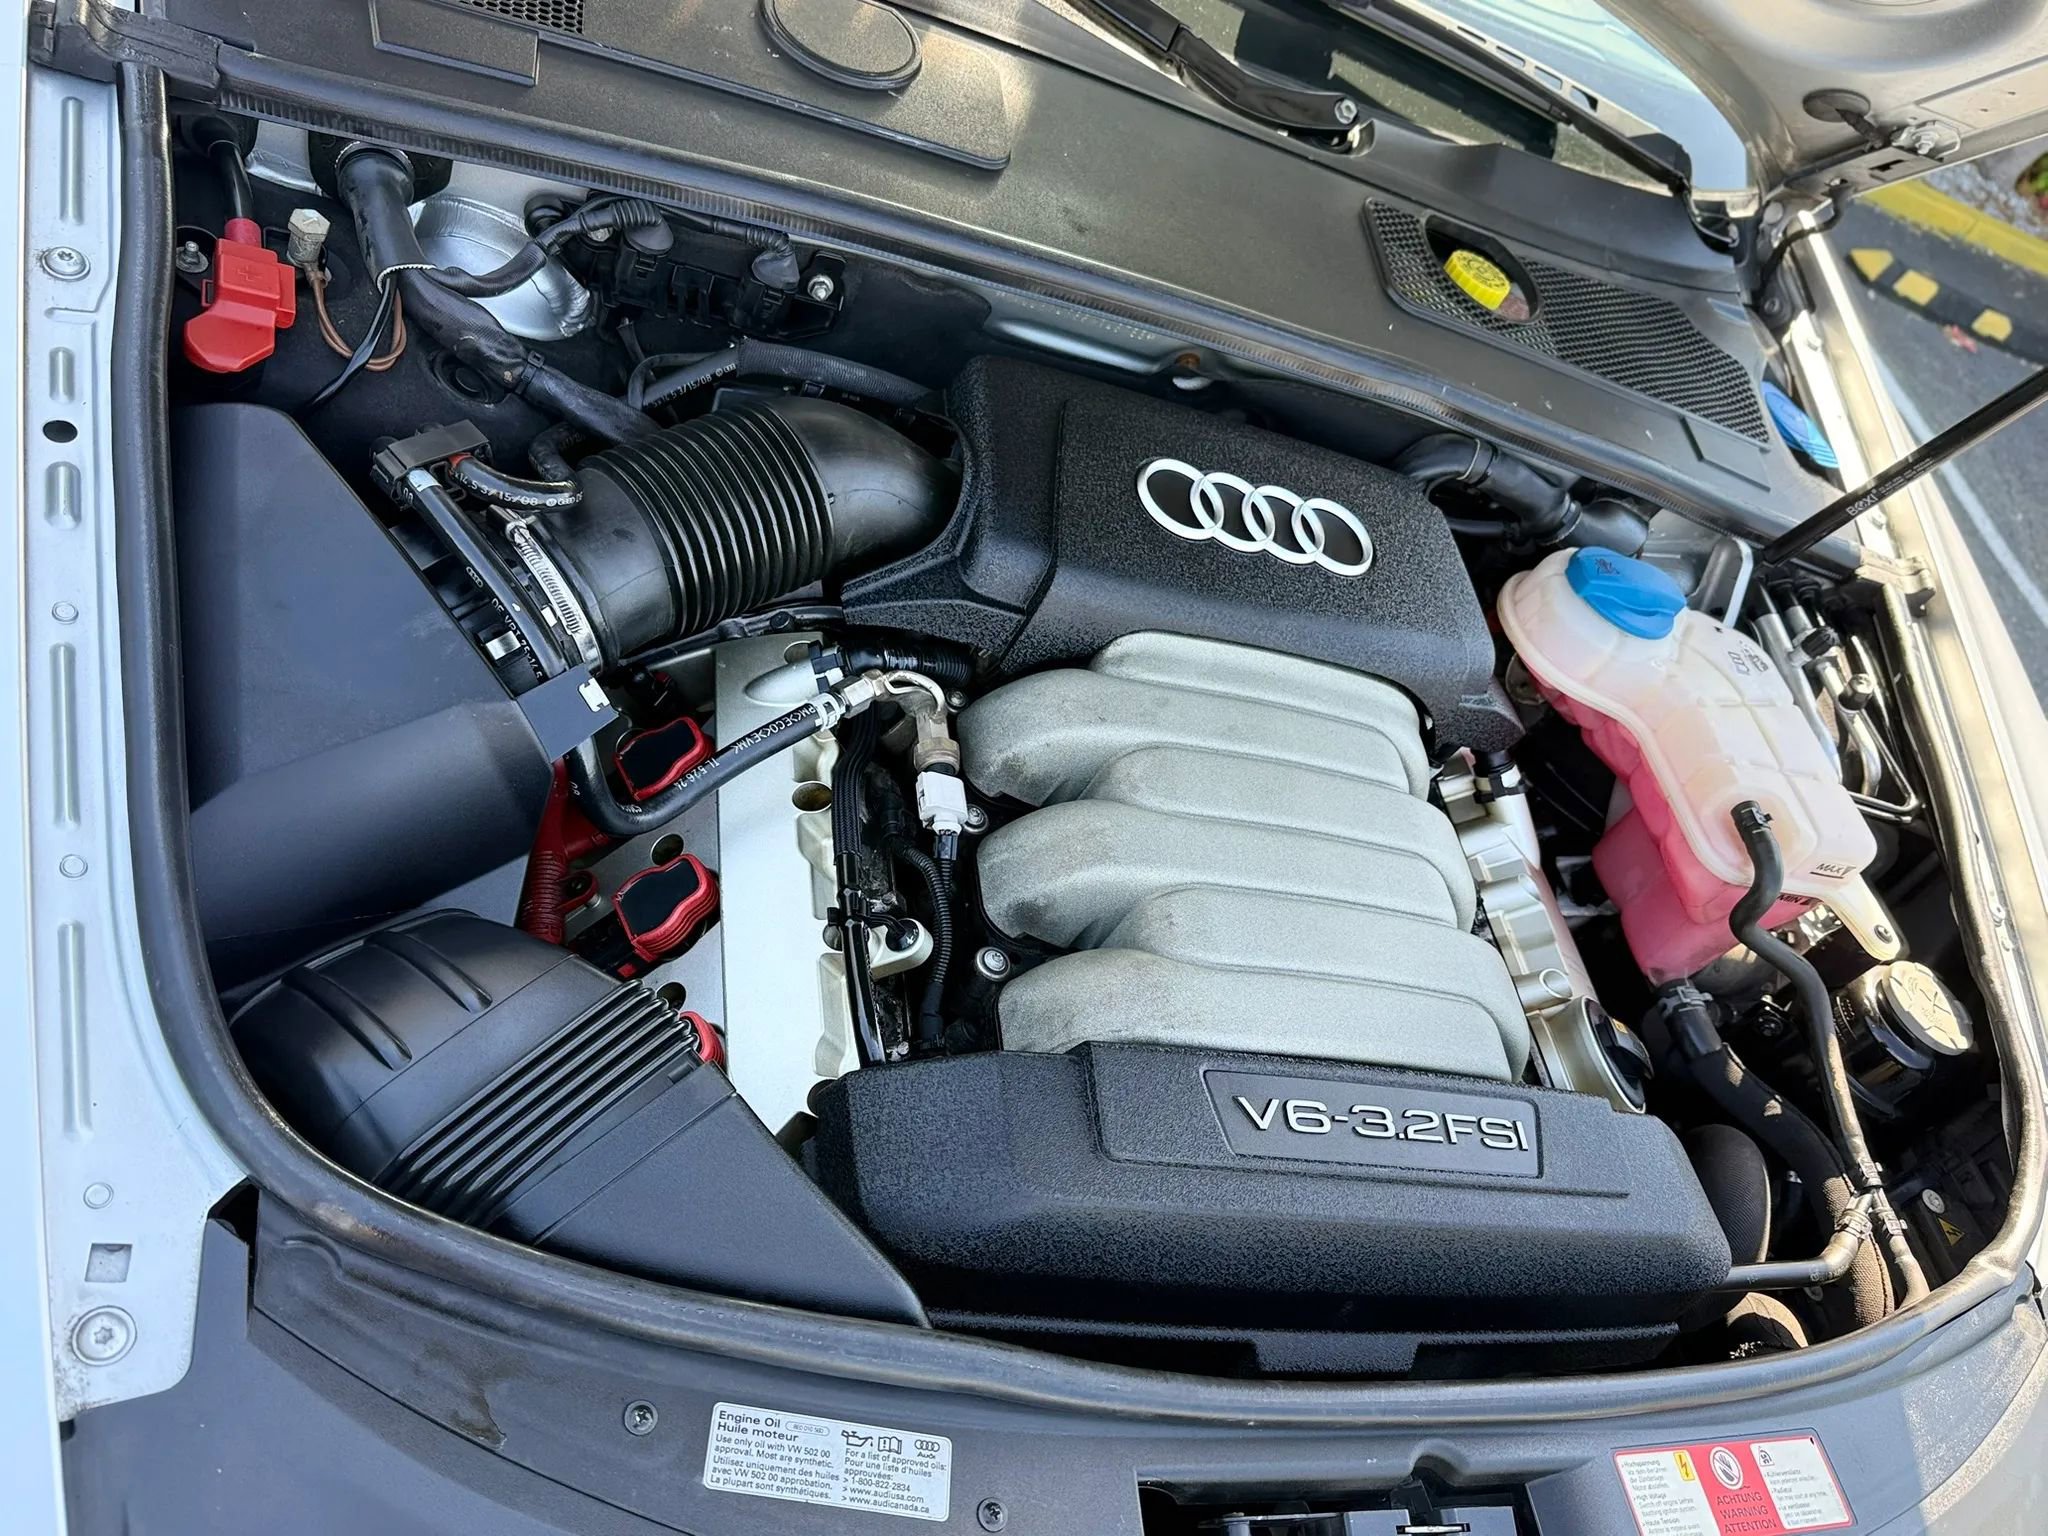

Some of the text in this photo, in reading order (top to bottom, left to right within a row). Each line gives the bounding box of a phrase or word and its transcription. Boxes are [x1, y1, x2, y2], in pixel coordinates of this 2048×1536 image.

[1816, 863, 1844, 874] MAX
[1779, 893, 1802, 904] MIN
[1232, 1095, 1529, 1150] V6-3.2FSI
[719, 1410, 780, 1428] Engine Oil
[717, 1421, 799, 1442] Huile moteur
[716, 1434, 831, 1459] Use only oil with VW 502 00
[917, 1451, 936, 1459] Audi
[714, 1445, 834, 1469] approval. Most are synthetic.
[846, 1448, 859, 1457] For
[867, 1450, 880, 1461] list
[881, 1453, 890, 1462] of
[892, 1456, 929, 1468] approved
[931, 1461, 947, 1471] oils:
[713, 1455, 840, 1481] Utilisez uniquement des huiles
[844, 1467, 894, 1480] approuvées:
[845, 1457, 932, 1477] Pour une liste d'huiles
[710, 1474, 831, 1499] La plupart sont synthétiques.
[712, 1466, 833, 1490] avec VW 502 00 approbation.
[851, 1476, 911, 1492] 1-800-822-2834
[849, 1486, 924, 1503] www.audiusa.com
[1716, 1491, 1763, 1506] ACHTUNG
[848, 1496, 930, 1513] www.audicanada.ca
[1720, 1505, 1768, 1520] WARNING
[1724, 1518, 1777, 1534] ATTENTION
